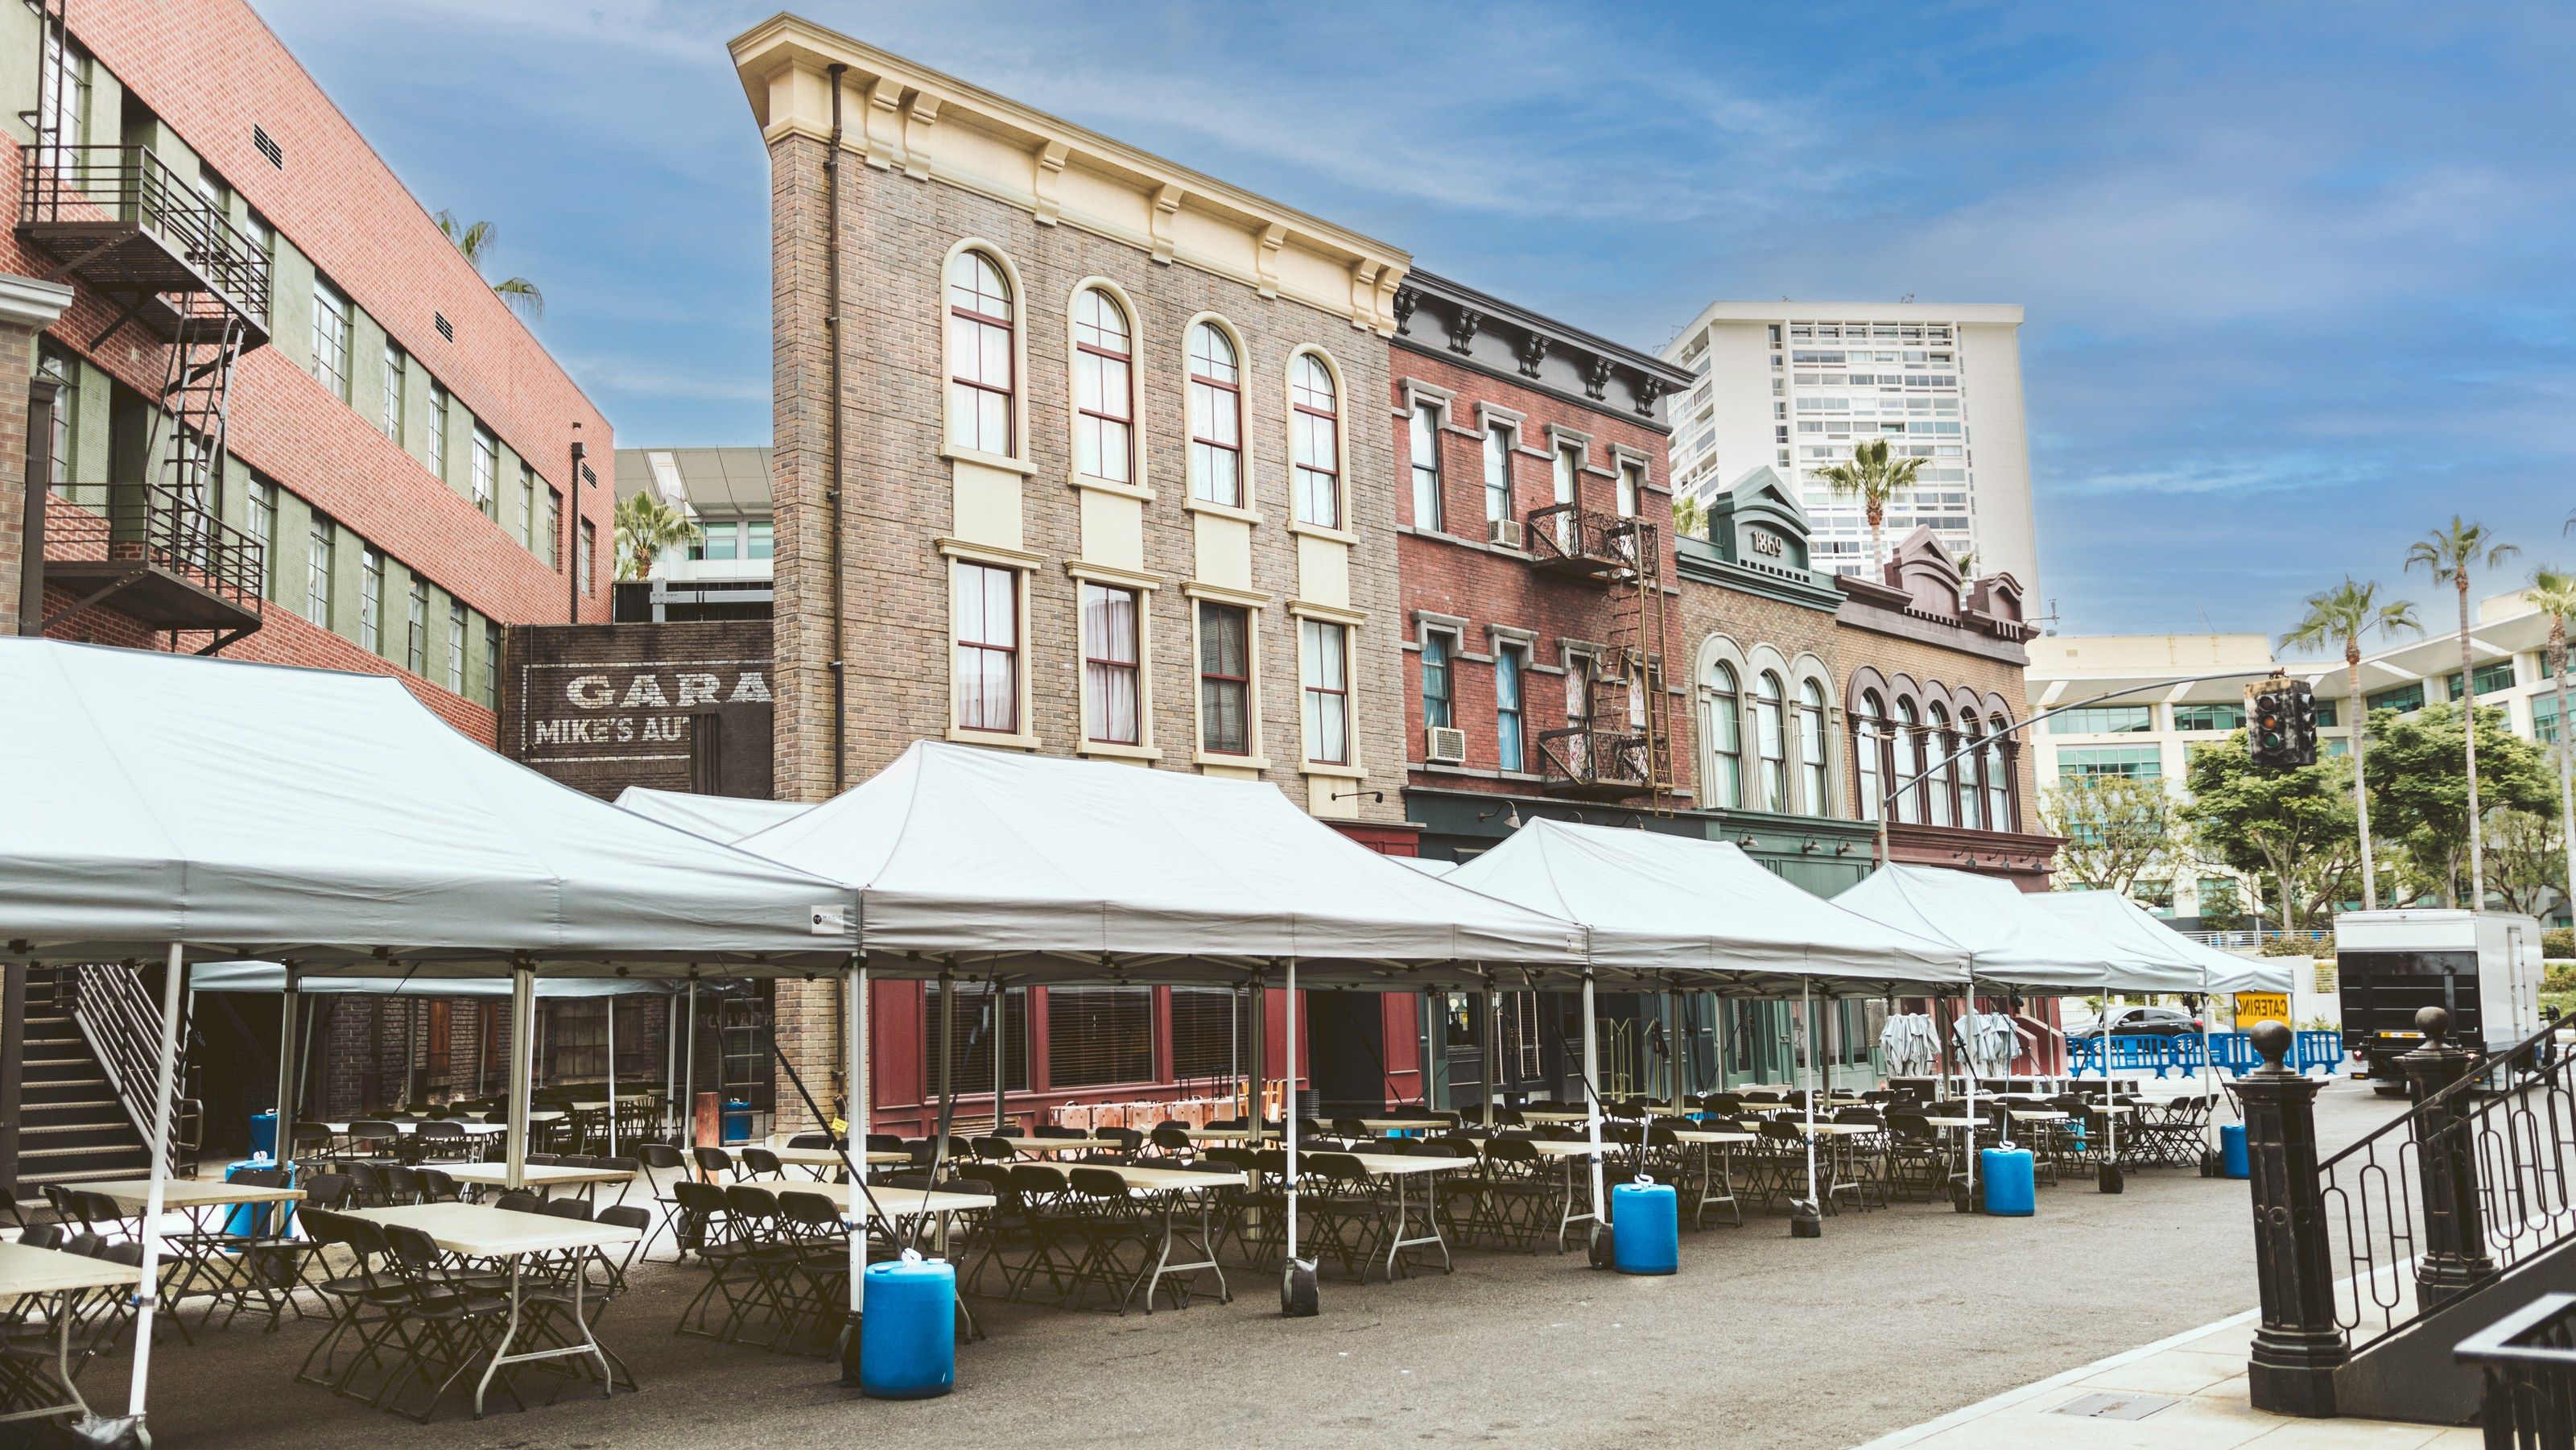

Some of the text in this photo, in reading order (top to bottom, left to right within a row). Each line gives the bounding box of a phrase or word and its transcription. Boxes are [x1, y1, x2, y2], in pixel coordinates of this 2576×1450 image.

[1752, 531, 1783, 557] 1869
[566, 671, 774, 708] GARA
[535, 717, 634, 745] MIKE'S
